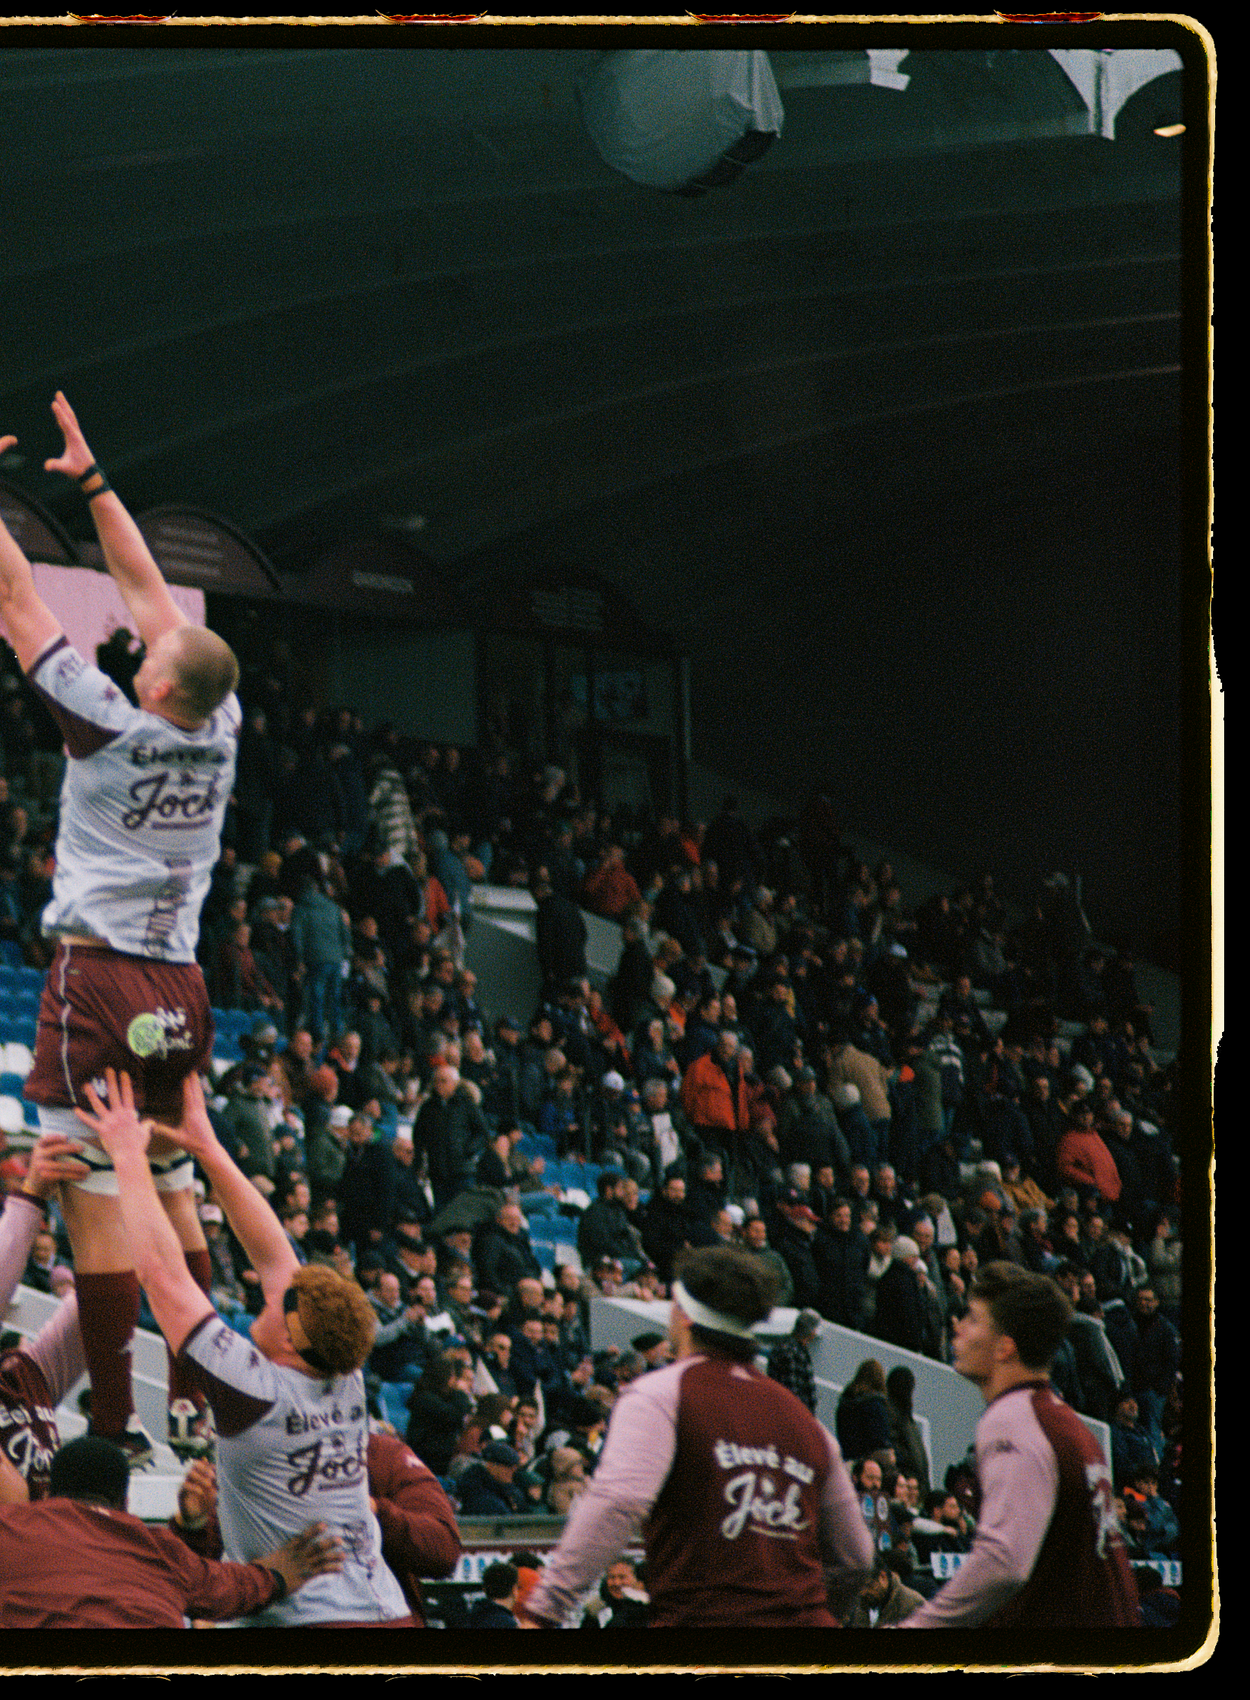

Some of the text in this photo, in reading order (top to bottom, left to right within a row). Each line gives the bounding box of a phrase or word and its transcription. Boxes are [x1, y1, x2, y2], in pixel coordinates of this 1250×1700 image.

[285, 1402, 343, 1436] Élevé
[714, 1438, 815, 1485] Élevé au
[721, 1471, 813, 1540] Jock
